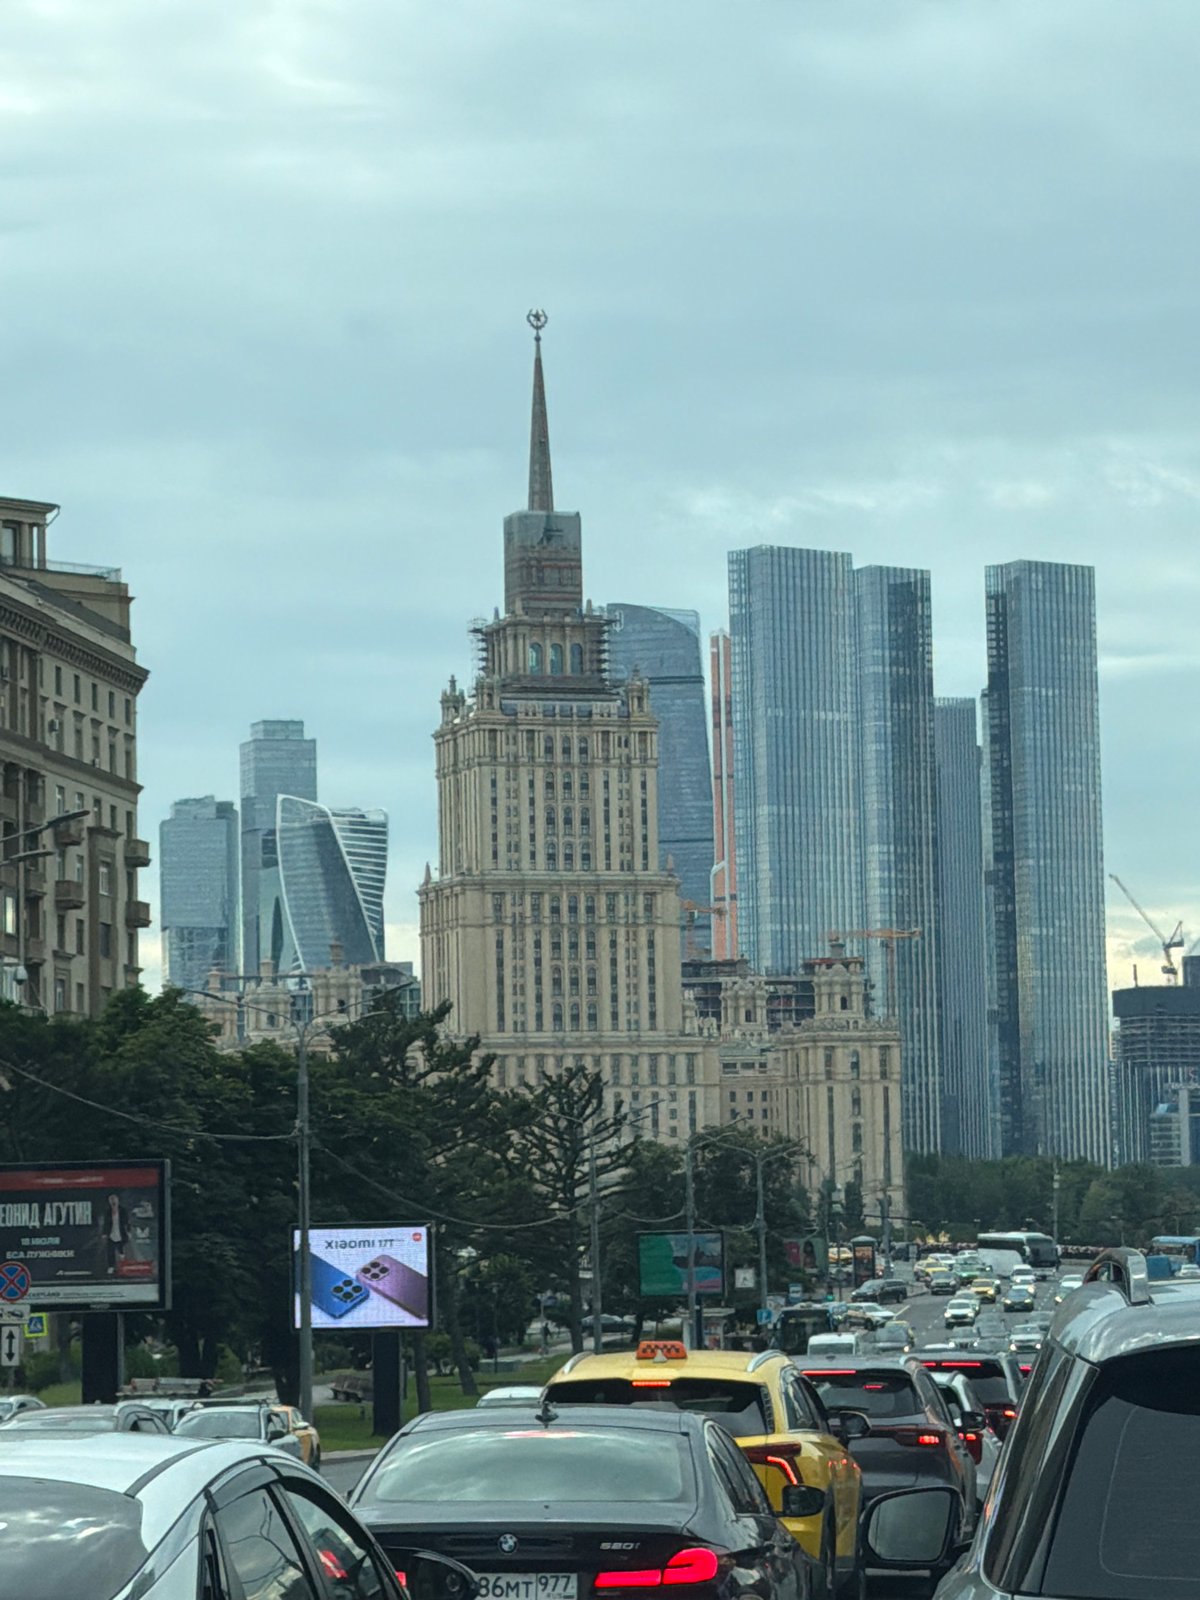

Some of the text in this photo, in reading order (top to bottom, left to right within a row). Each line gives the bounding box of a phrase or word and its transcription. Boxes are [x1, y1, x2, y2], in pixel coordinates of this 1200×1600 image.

[0, 1201, 92, 1229] ЕОНИД АГУТИН
[478, 1575, 571, 1598] 86МТ 977
